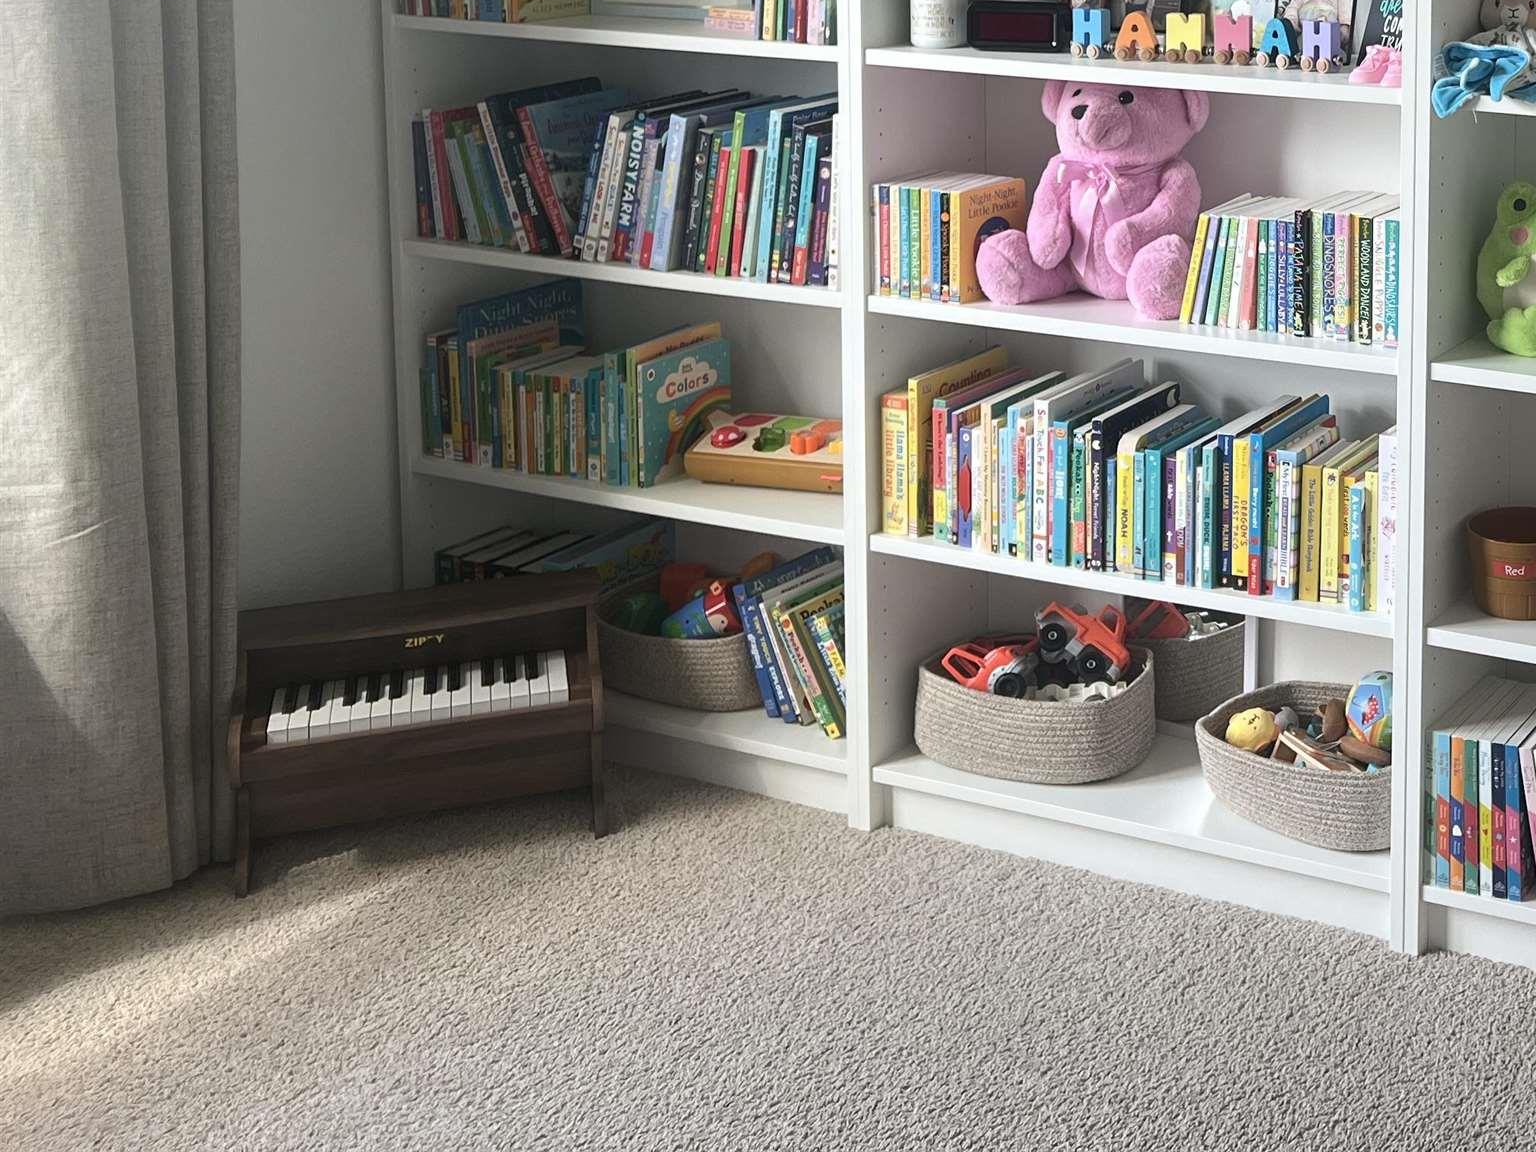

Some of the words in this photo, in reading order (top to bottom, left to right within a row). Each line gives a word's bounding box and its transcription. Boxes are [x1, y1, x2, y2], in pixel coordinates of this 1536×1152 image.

[1072, 8, 1340, 65] HANNAH
[626, 126, 645, 180] NOISY
[618, 182, 635, 226] FARM
[968, 205, 990, 220] Little
[911, 210, 919, 238] Little
[911, 241, 919, 277] Pookie
[1293, 241, 1304, 282] PAJAMA
[1323, 235, 1335, 312] DINOSNORES
[1360, 239, 1371, 286] WOODLAND
[478, 299, 521, 322] Night
[1277, 283, 1286, 323] LULLABY
[1360, 287, 1371, 320] DANCE!
[666, 372, 709, 398] Colors
[885, 429, 895, 456] little
[896, 430, 905, 460] llama
[884, 459, 895, 497] library
[896, 462, 905, 500] llama's
[1222, 462, 1230, 486] LLAMA
[1222, 486, 1230, 510] LLAMA
[1120, 508, 1128, 538] NOAH
[1240, 500, 1248, 548] DRAGON'S
[1351, 523, 1359, 540] Ark
[1504, 563, 1526, 577] Red
